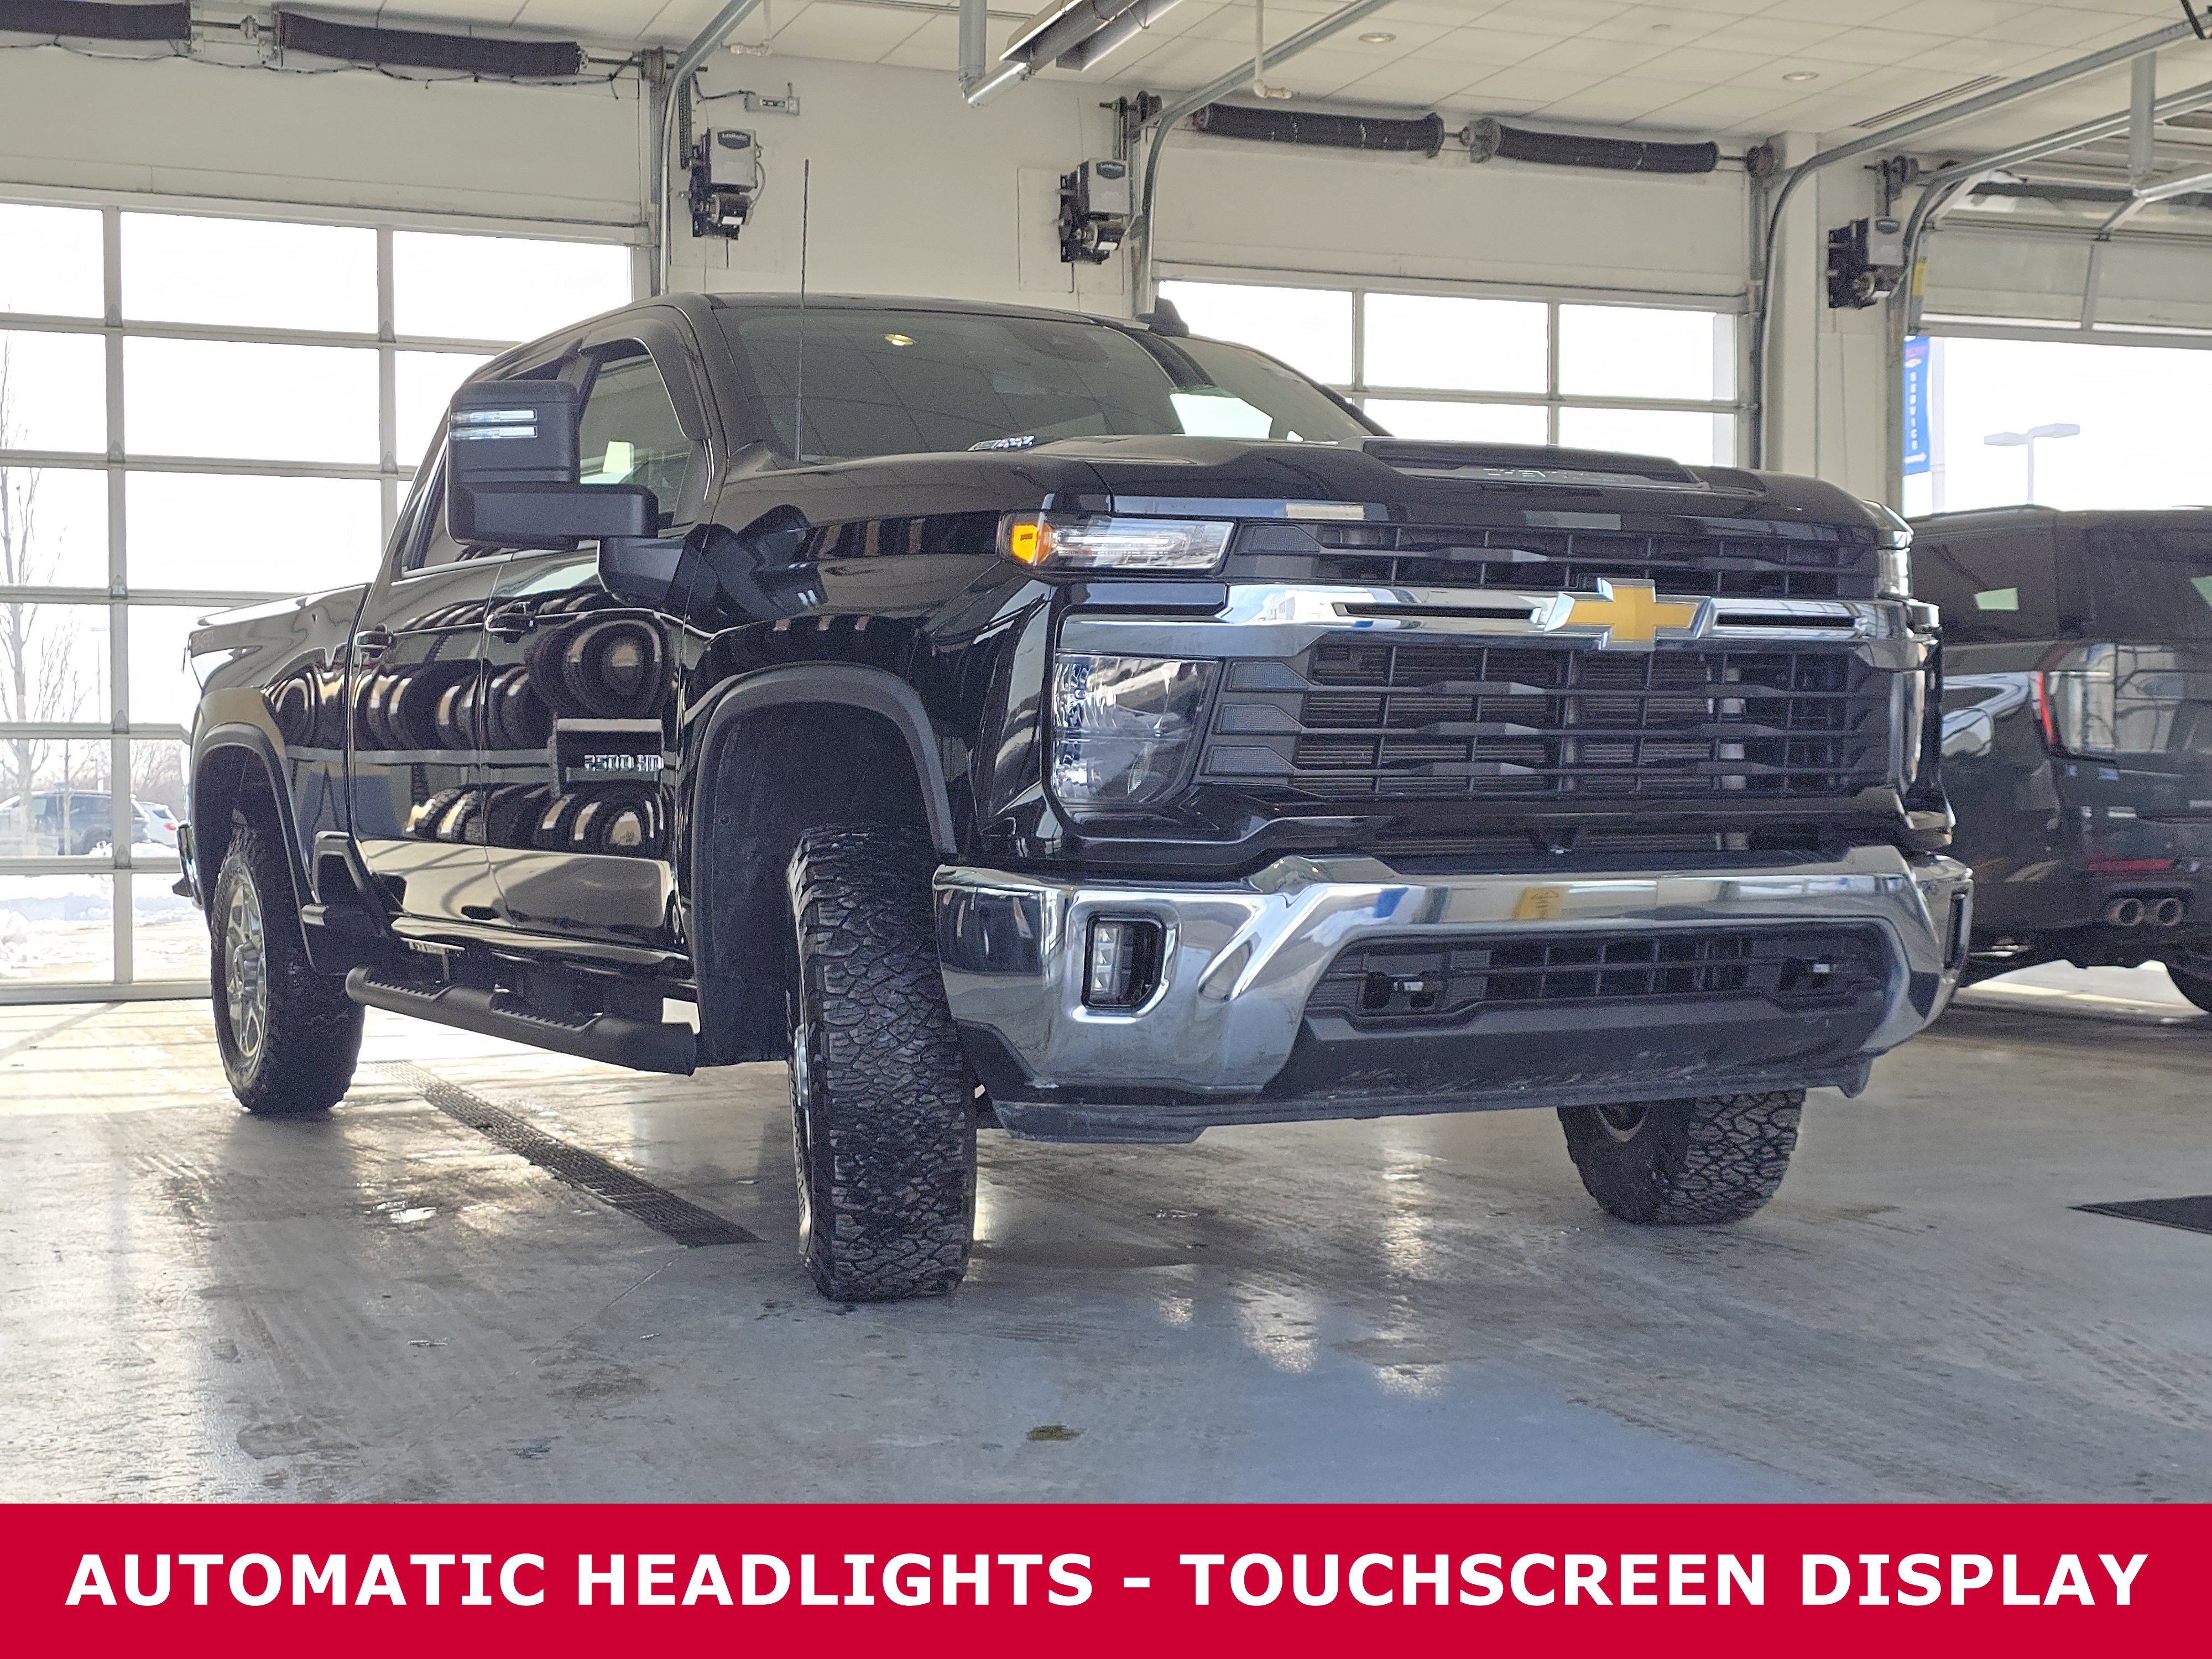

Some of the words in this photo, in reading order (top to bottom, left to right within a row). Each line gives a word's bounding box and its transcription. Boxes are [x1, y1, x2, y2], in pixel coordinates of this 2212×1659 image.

[1909, 371, 1918, 451] SERVICE
[584, 754, 634, 771] 2500
[637, 754, 664, 771] HD
